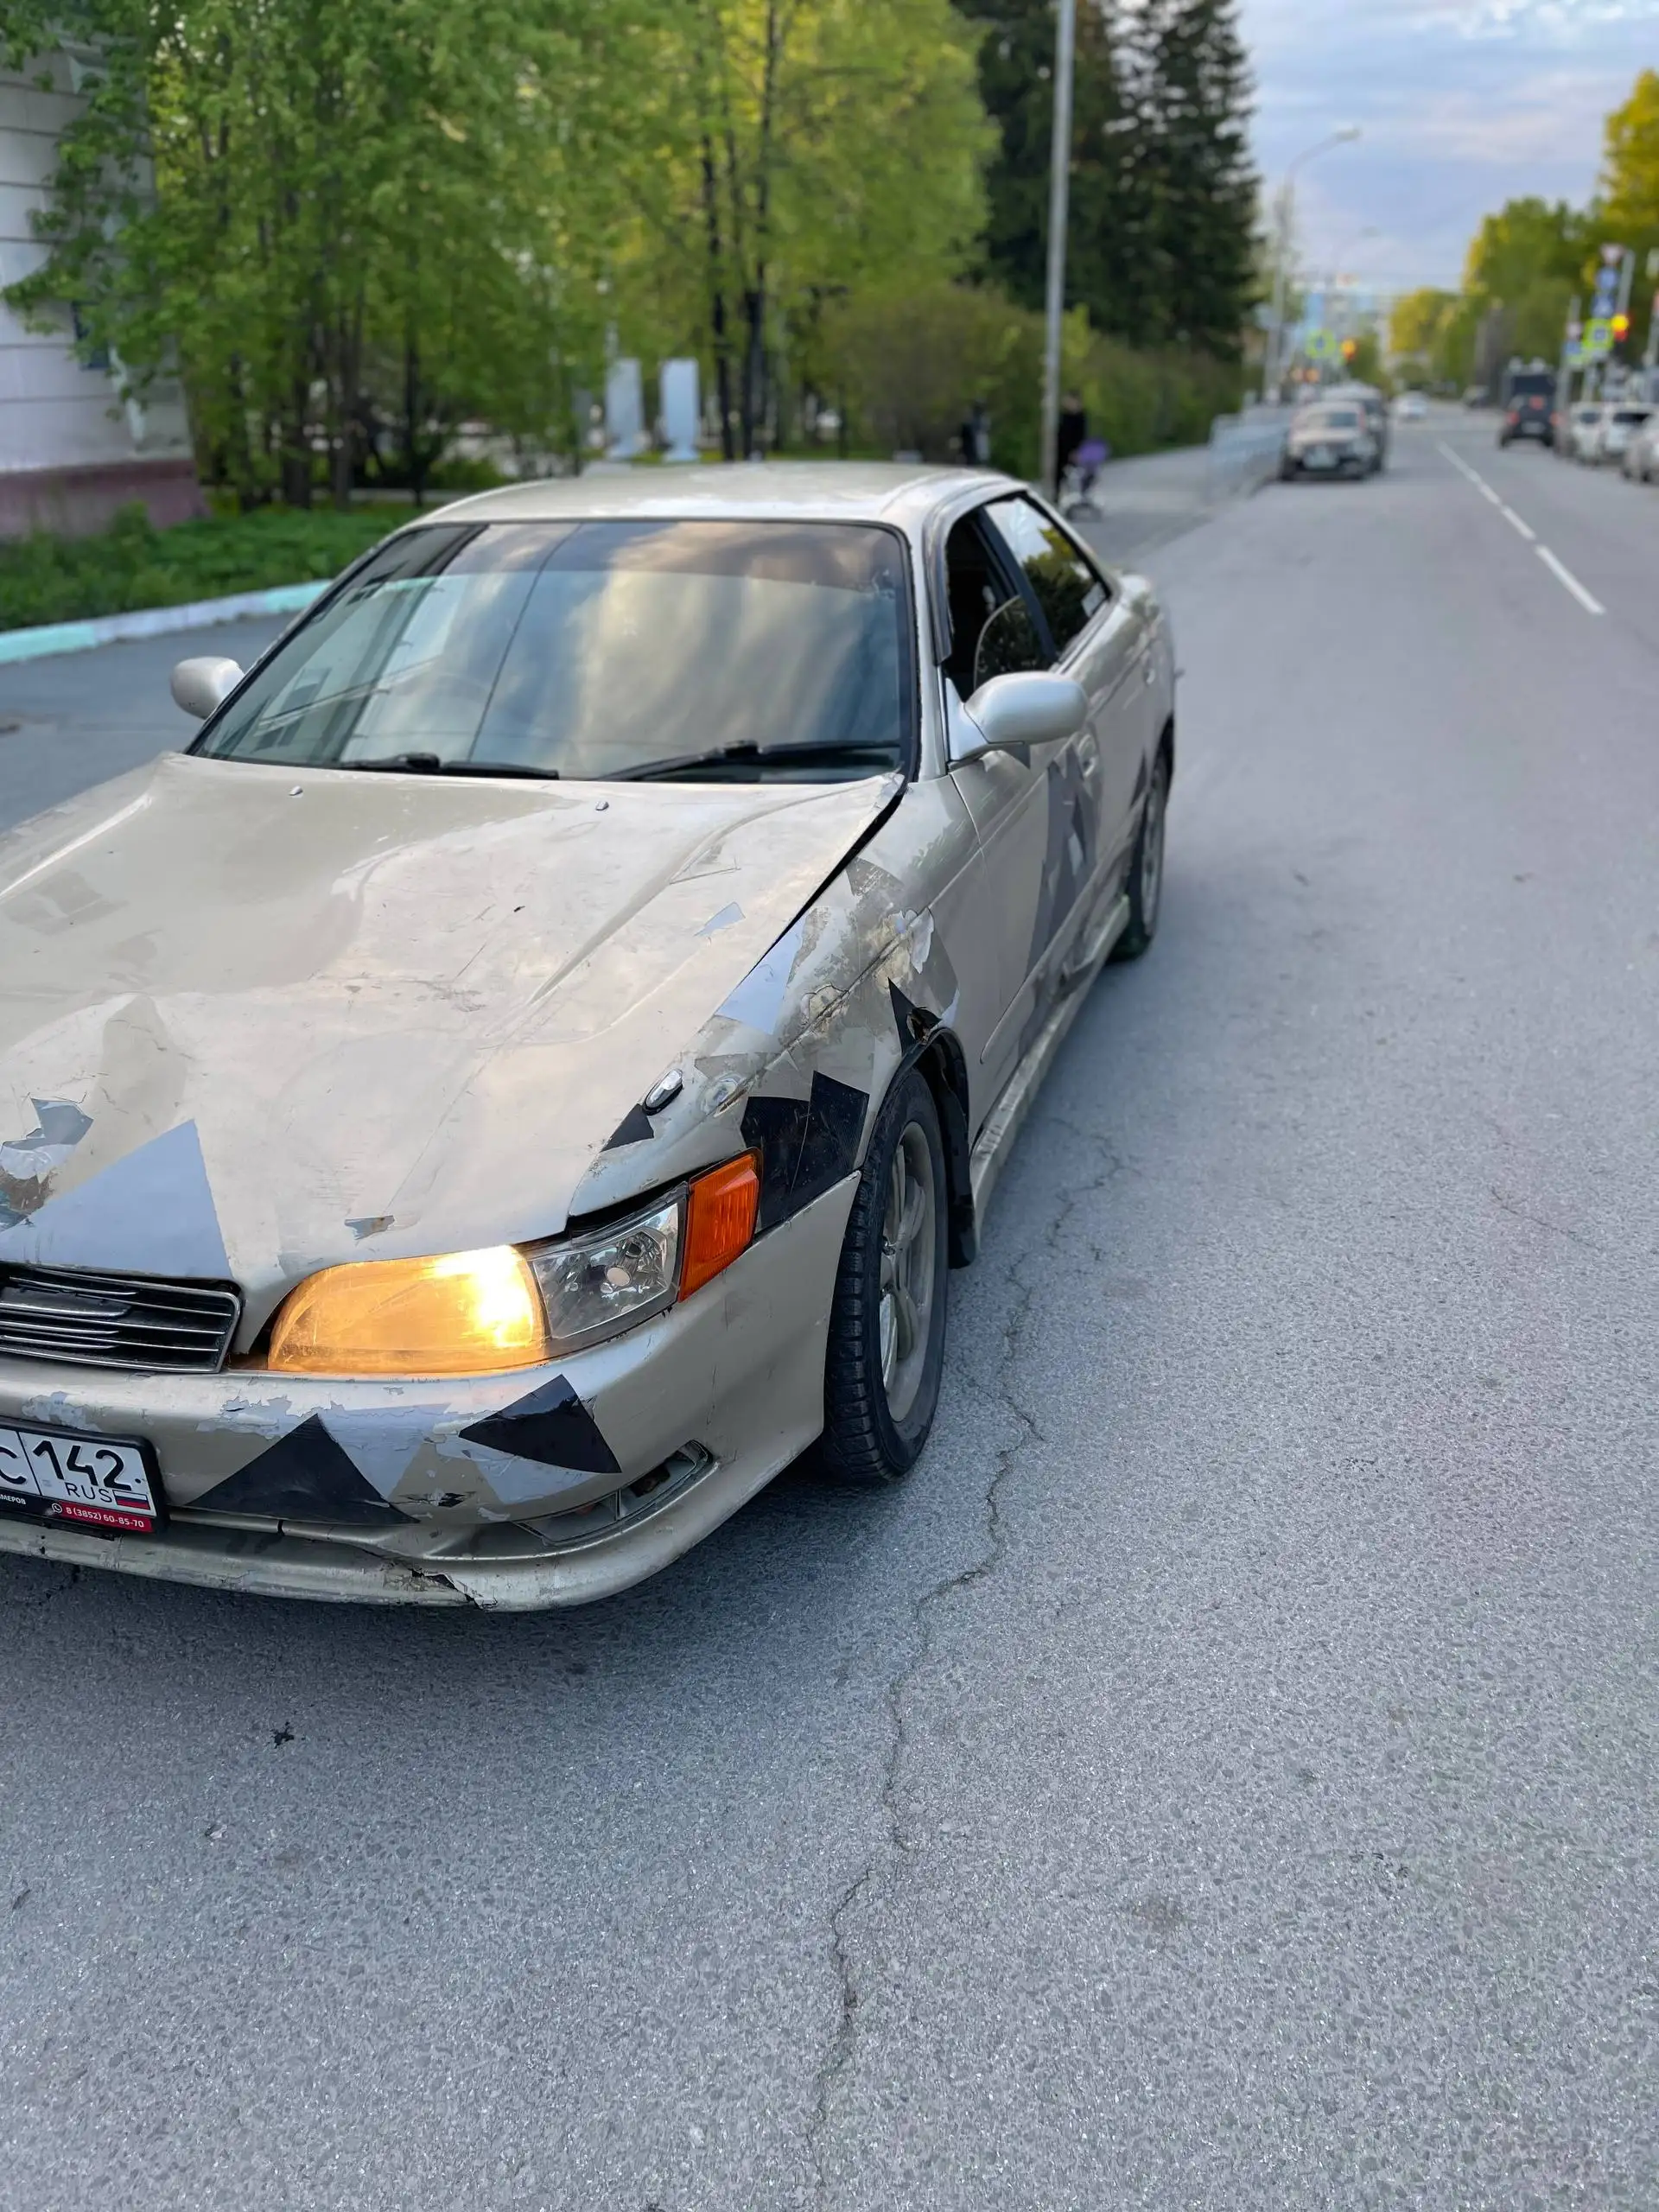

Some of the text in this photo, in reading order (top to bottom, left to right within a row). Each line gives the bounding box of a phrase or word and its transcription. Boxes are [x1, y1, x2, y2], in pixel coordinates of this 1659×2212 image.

[33, 1440, 132, 1491] 142
[0, 1494, 26, 1505] МЕРОВ
[65, 1482, 112, 1503] RUS
[73, 1507, 101, 1521] (3852)
[103, 1514, 144, 1528] 60-85-70
